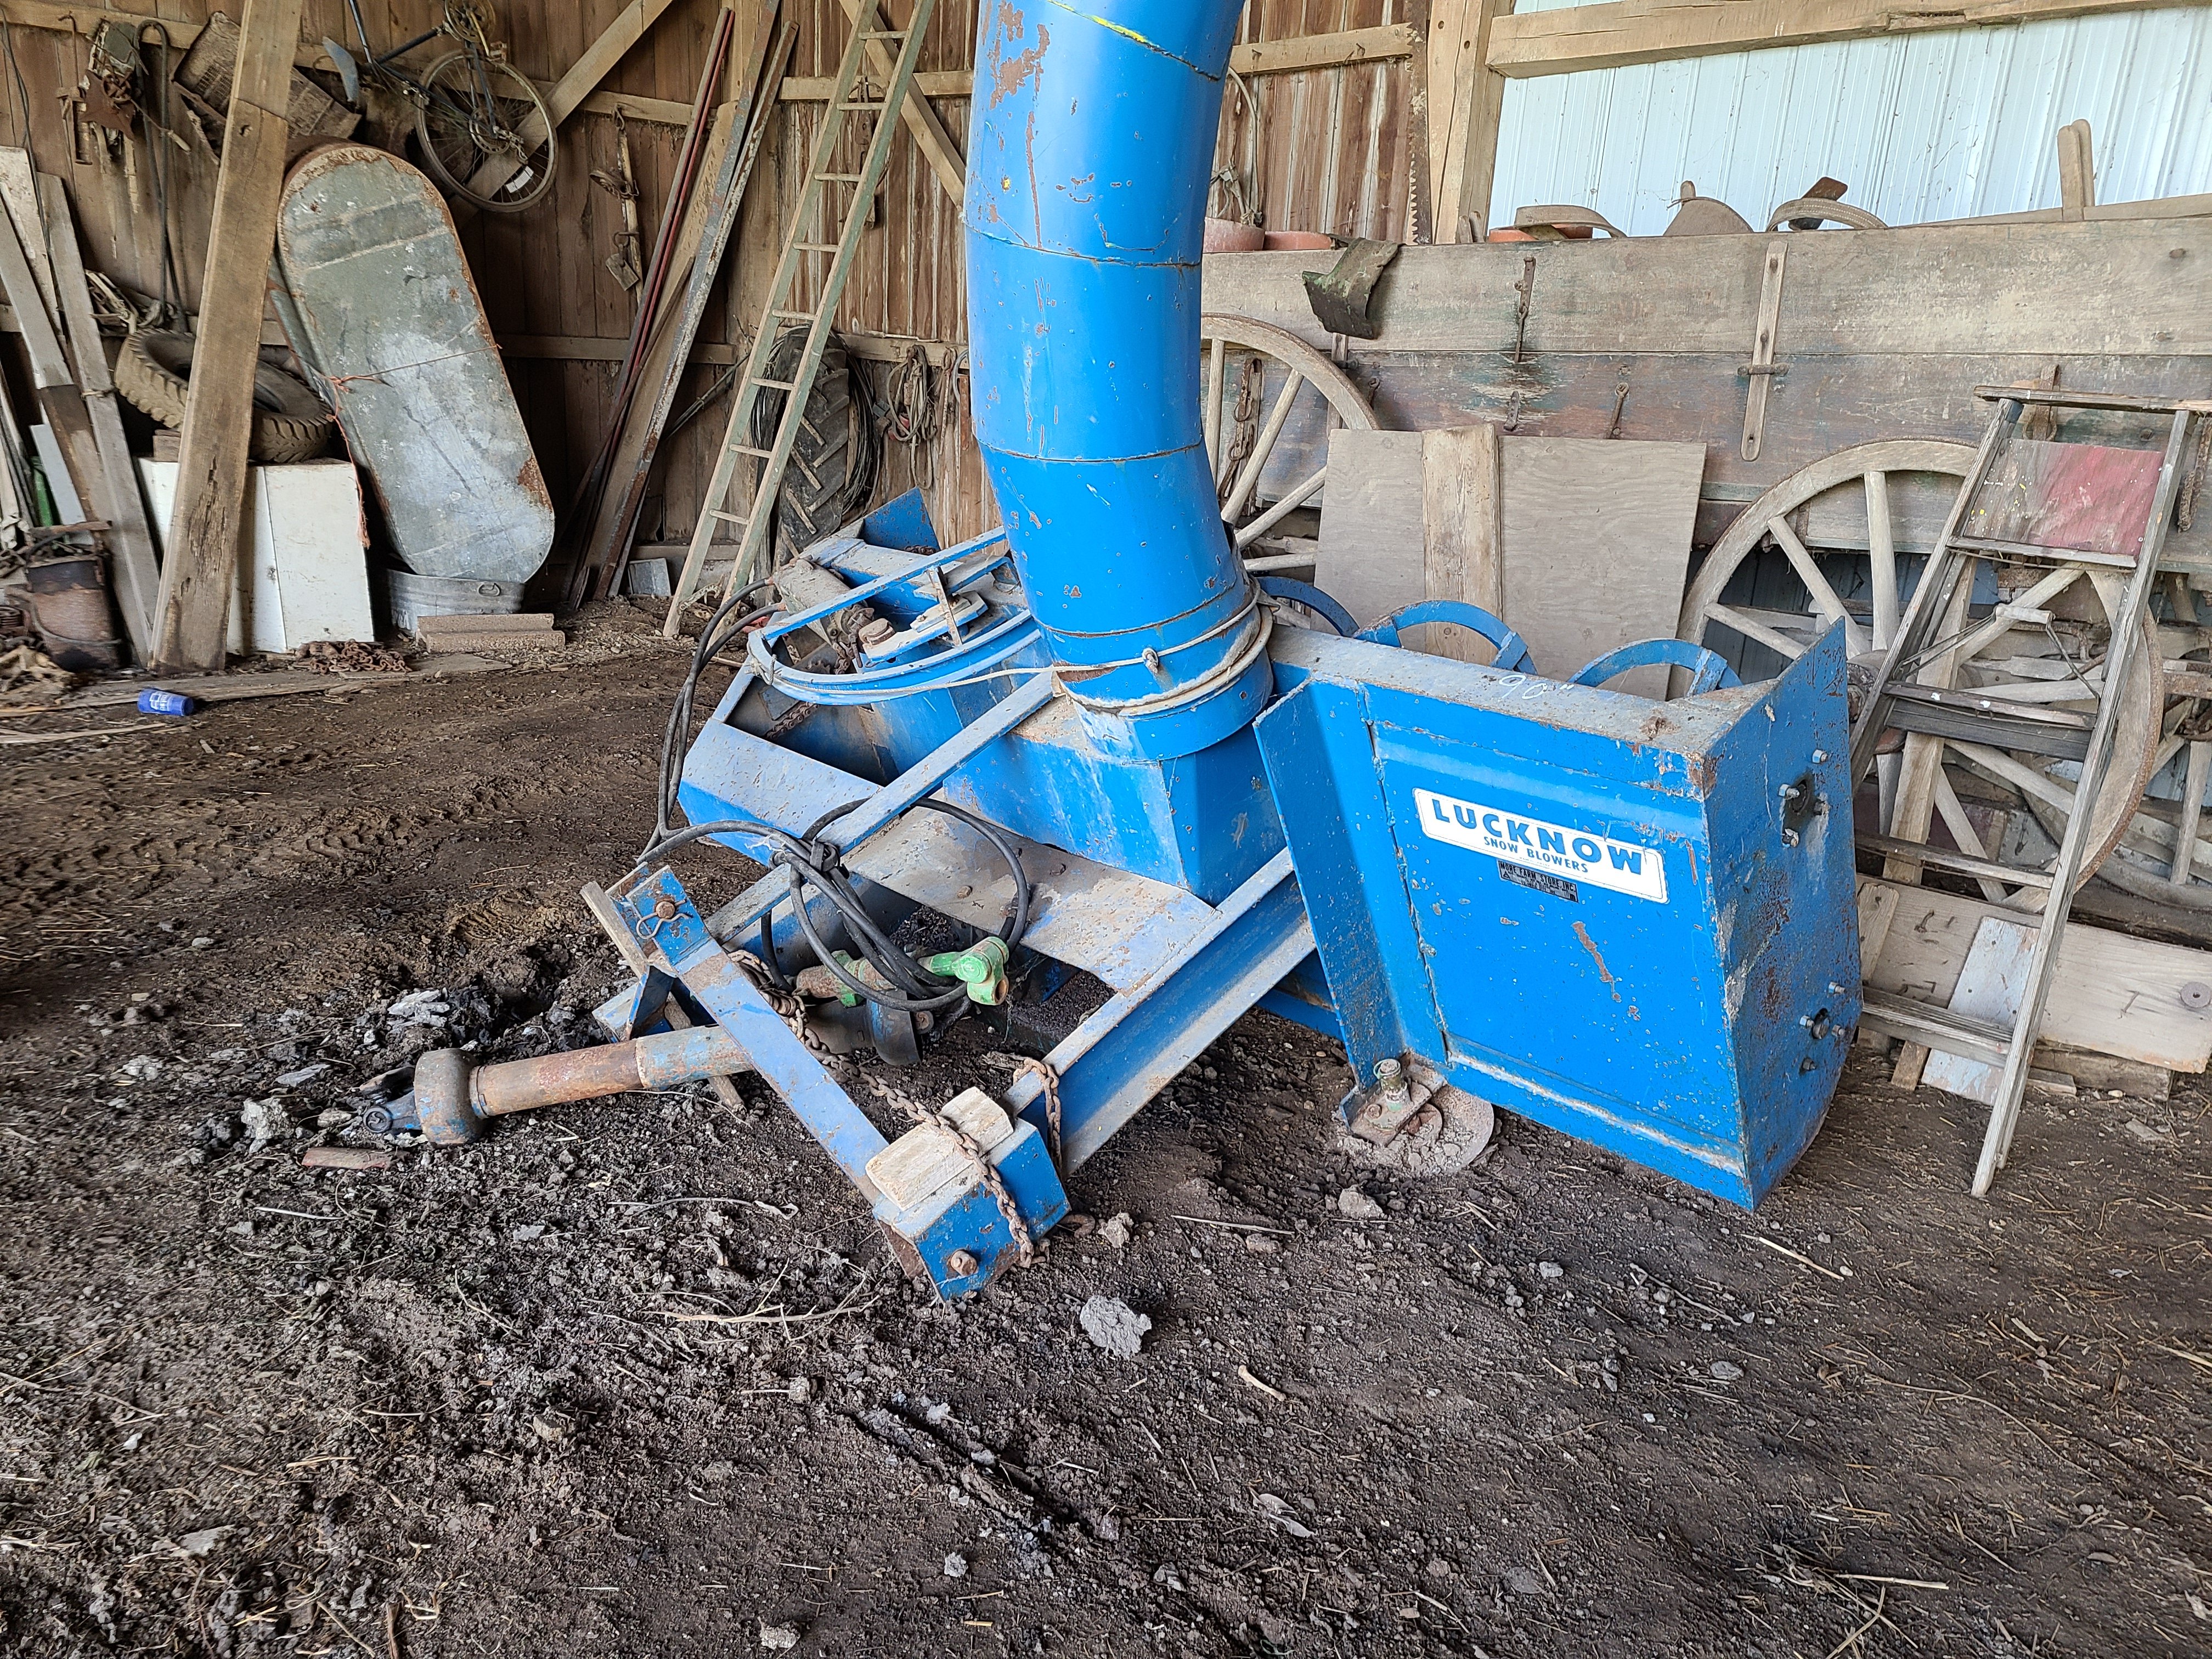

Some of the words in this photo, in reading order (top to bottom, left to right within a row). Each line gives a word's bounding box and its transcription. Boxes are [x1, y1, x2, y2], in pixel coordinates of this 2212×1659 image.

[1432, 799, 1642, 875] LUCKNOW
[1483, 836, 1518, 854] SNOW
[1526, 848, 1589, 873] BLOWERS
[1500, 861, 1517, 873] MORE
[1520, 867, 1537, 880] FARM
